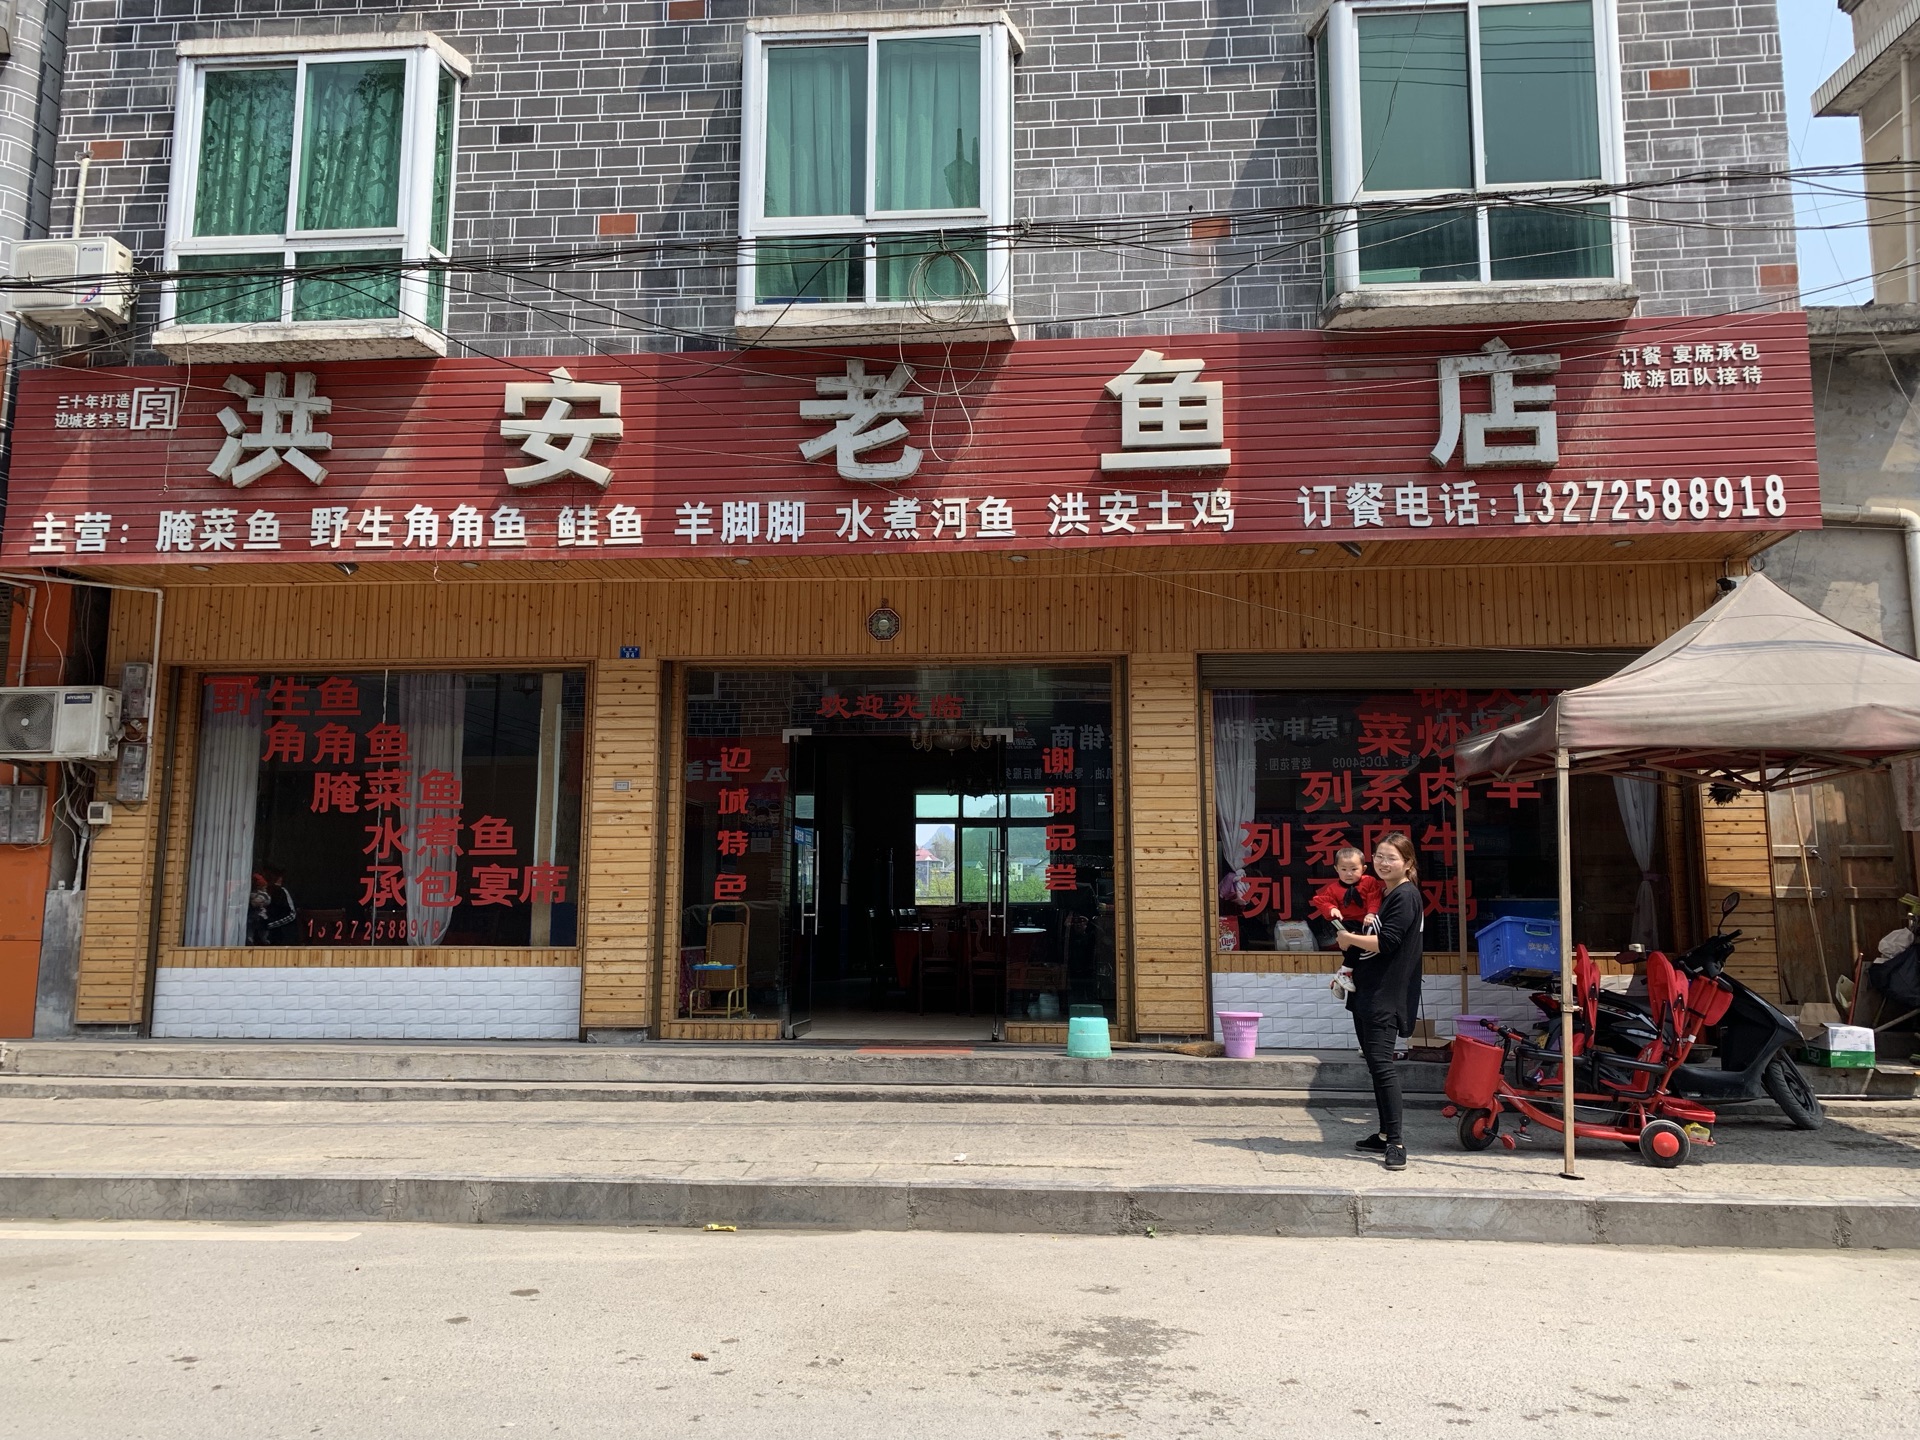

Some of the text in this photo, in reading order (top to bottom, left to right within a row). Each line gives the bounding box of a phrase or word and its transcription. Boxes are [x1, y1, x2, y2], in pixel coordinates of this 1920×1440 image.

[1619, 342, 1761, 366] 订餐 宴席承包
[1622, 365, 1764, 389] 旅游团队接待
[54, 413, 130, 429] 边城老字号
[56, 393, 131, 409] 三十年打造
[207, 336, 1562, 488] 洪安老鱼店
[155, 506, 283, 553] 腌菜鱼
[310, 503, 528, 549] 野生角角鱼
[557, 502, 643, 547] 鲑鱼
[675, 499, 806, 544] 羊脚脚
[836, 494, 1016, 541] 水煮河鱼
[1048, 487, 1237, 536] 洪安土鸡
[203, 674, 362, 717] 野生鱼
[817, 693, 965, 720] 欢迎光临
[262, 720, 412, 765] 角角鱼
[310, 768, 464, 813] 腌菜鱼
[363, 814, 518, 859] 水煮鱼
[714, 746, 751, 900] 边城特色
[1042, 747, 1077, 891] 谢谢品尝
[359, 861, 570, 908] 承包宴席
